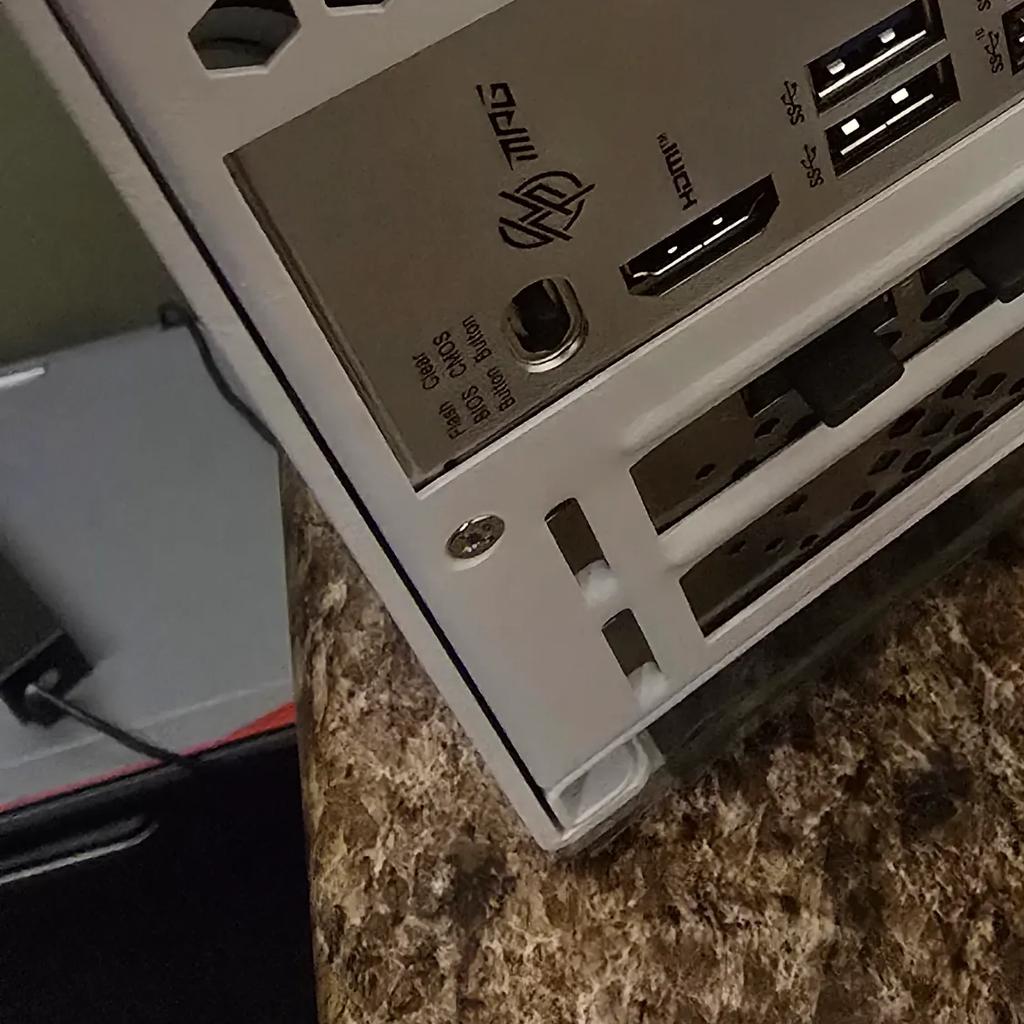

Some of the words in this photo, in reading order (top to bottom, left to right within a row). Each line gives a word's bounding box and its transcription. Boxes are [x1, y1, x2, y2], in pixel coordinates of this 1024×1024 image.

[432, 330, 467, 378] CMOS
[462, 314, 492, 363] Button
[412, 352, 440, 390] Clear
[486, 366, 517, 412] Button
[438, 400, 468, 440] Flash
[462, 385, 491, 425] BIOS
